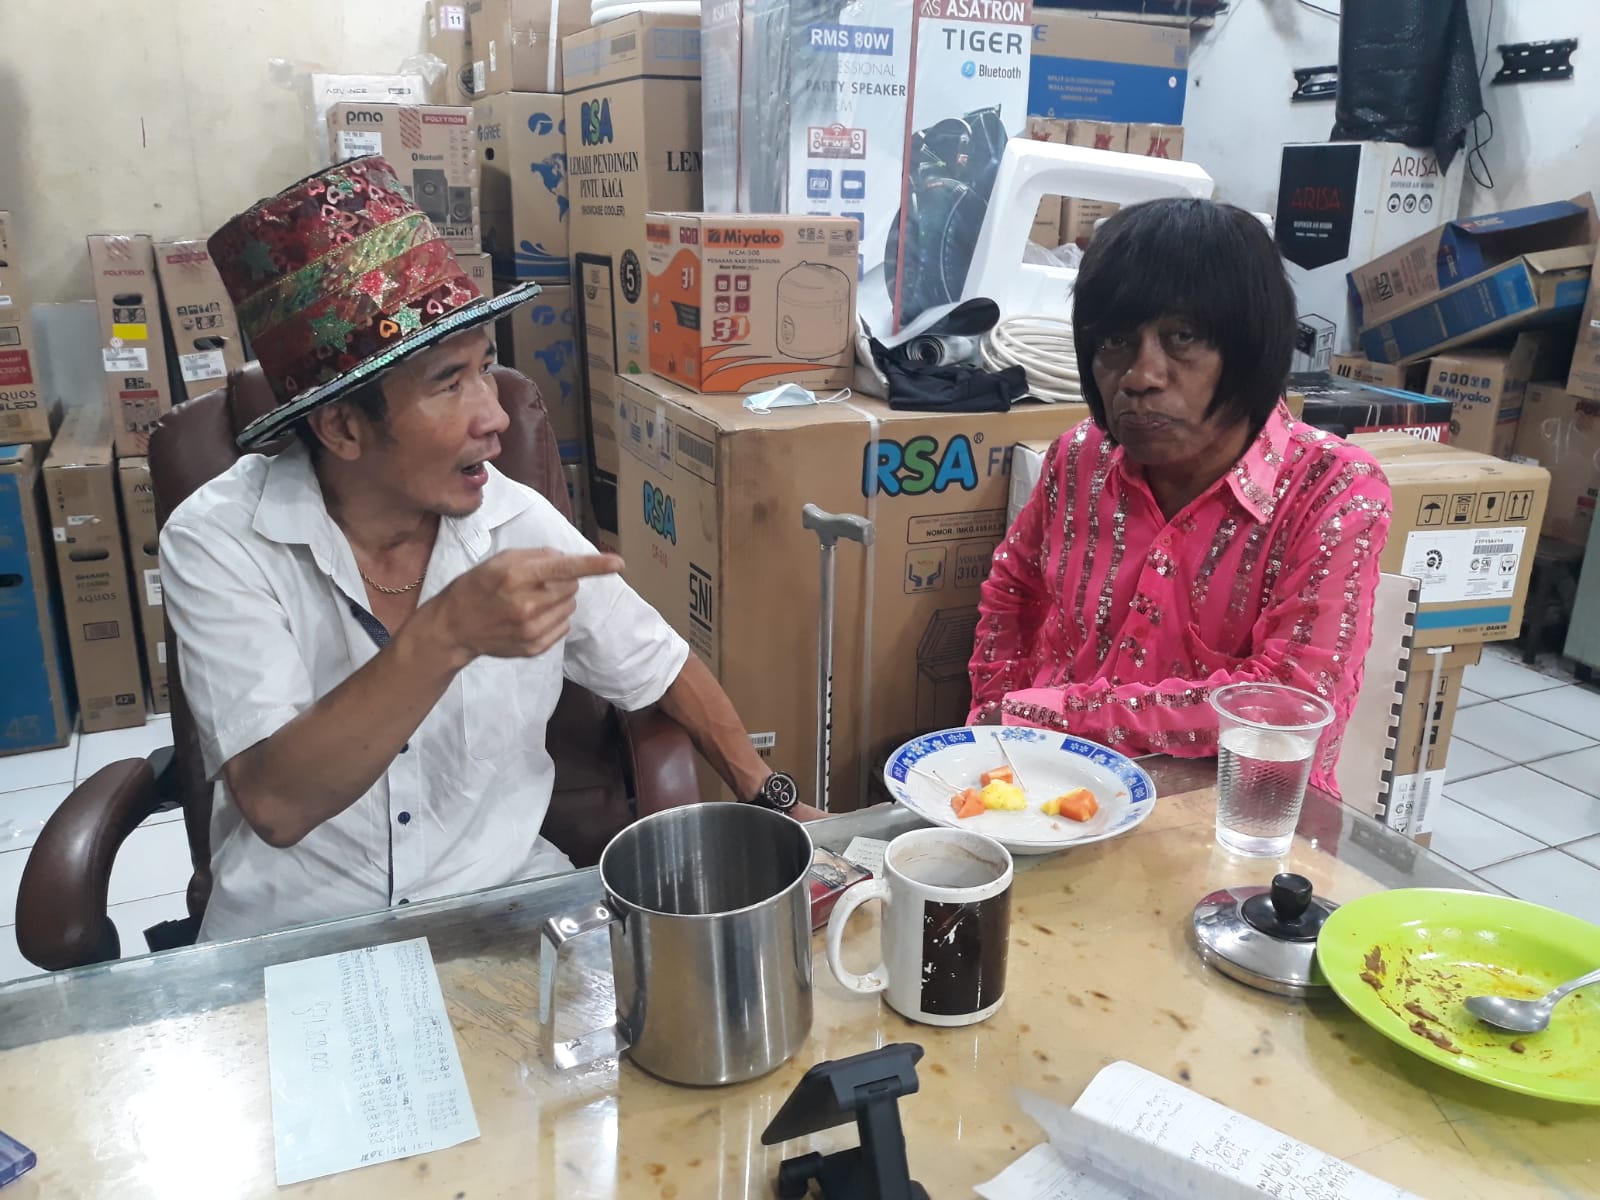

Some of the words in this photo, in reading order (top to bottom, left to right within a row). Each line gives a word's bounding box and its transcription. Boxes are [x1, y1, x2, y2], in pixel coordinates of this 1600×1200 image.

[945, 0, 1025, 21] ASATRON
[810, 28, 849, 47] RMS
[854, 32, 890, 50] 80W
[942, 28, 1023, 55] TIGER
[979, 64, 1021, 79] Bluetooth
[806, 80, 846, 94] PARTY
[851, 82, 906, 97] SPEAKER
[346, 110, 384, 125] pma
[424, 115, 465, 124] POLYTRON
[581, 97, 613, 146] RSA
[569, 153, 592, 175] LEMARI
[593, 151, 639, 174] PENDINGIN
[1391, 156, 1439, 177] ARISA
[580, 179, 598, 198] PINTU
[601, 178, 624, 198] KACA
[1291, 186, 1344, 209] ARISA
[723, 230, 780, 247] Miyako
[0, 390, 36, 399] QUOS
[1444, 386, 1491, 405] Miyako
[862, 434, 978, 498] RSA
[643, 480, 676, 546] RSA
[926, 528, 953, 537] NOMOR
[958, 565, 979, 580] 310
[78, 592, 117, 602] AQUOS
[690, 572, 712, 623] SNI
